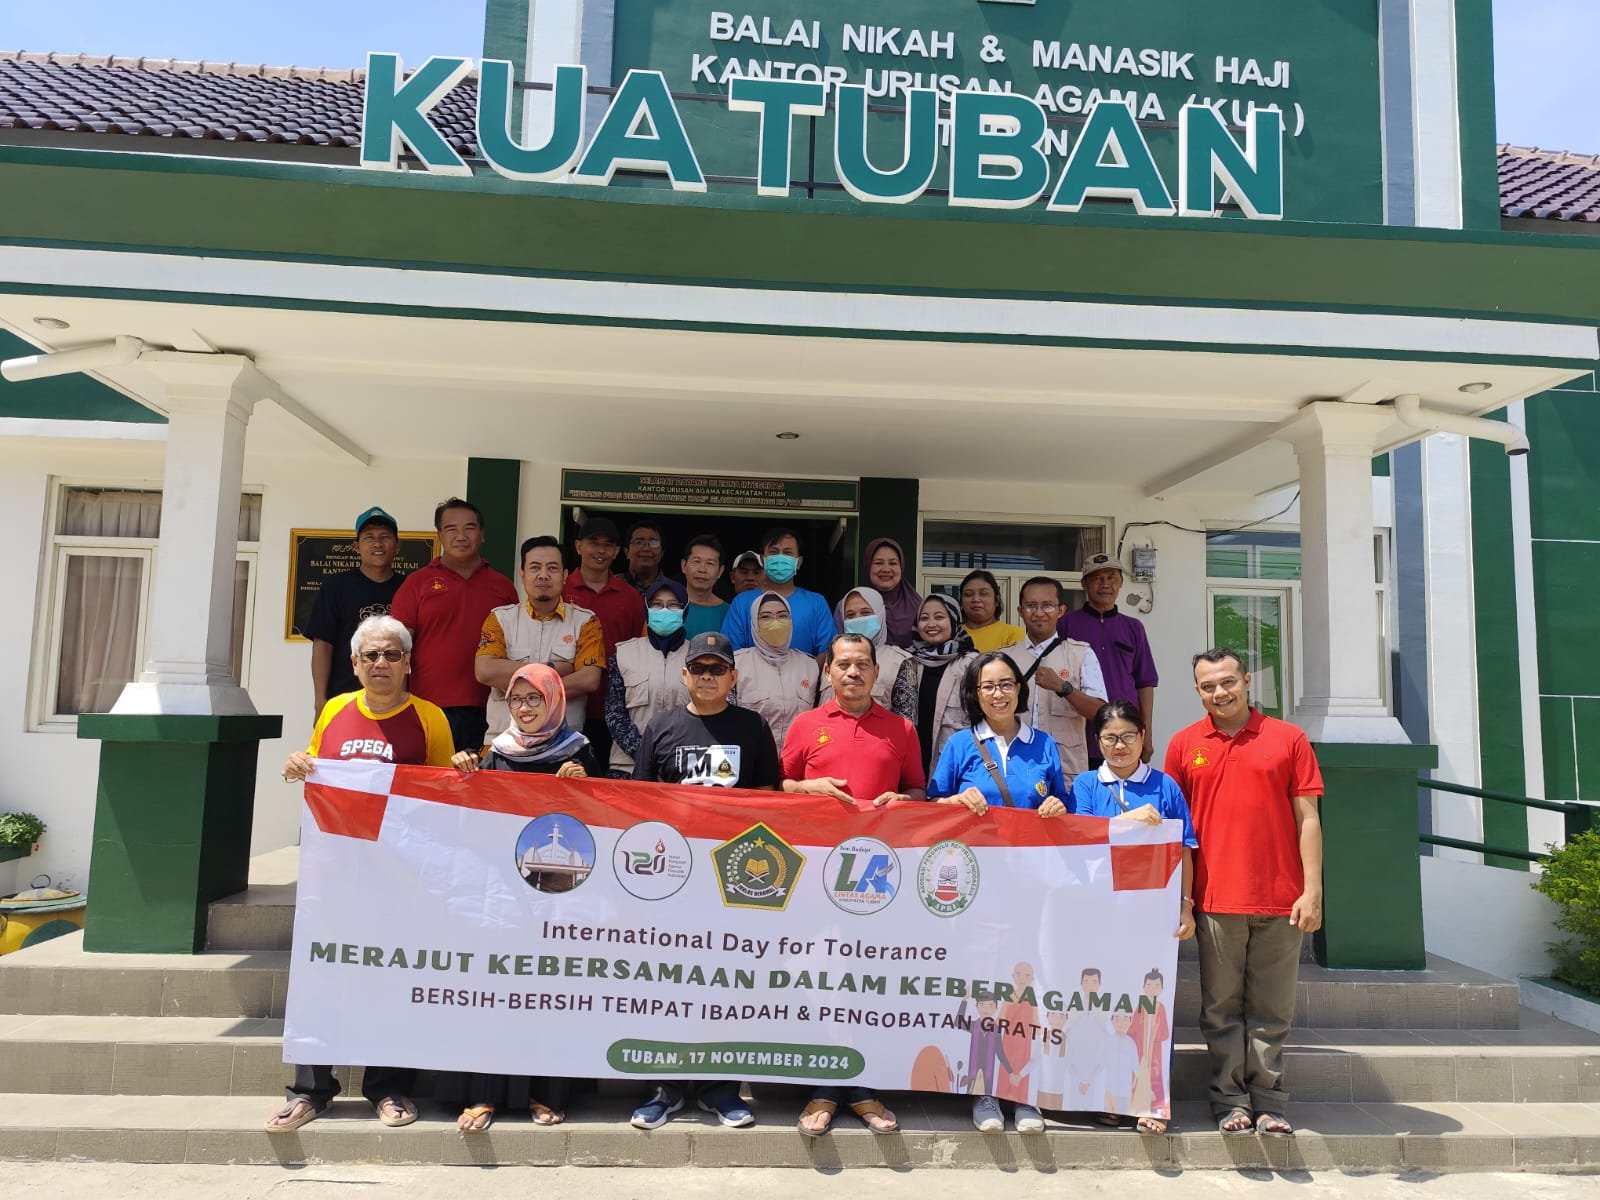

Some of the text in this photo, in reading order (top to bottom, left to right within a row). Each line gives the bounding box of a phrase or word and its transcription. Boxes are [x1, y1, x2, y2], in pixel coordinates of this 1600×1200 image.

[709, 11, 1290, 88] BALAI NIKAH & MANASIK HAJI
[360, 52, 1283, 220] KUA TUBAN
[340, 739, 393, 760] SPEGA
[834, 891, 887, 901] LINTAS AGAMA
[543, 921, 947, 961] International Day for Tolerance
[310, 941, 1157, 1015] MERAJUT KEBERSAMAAN DALAM KEBERAGAMAN
[411, 987, 1063, 1045] BERSIH-BERSIH TEMPAT IBADAH & PENGOBATAN GRATIS
[621, 1048, 849, 1070] TUBAN, 17 NOVEMBER 2024
